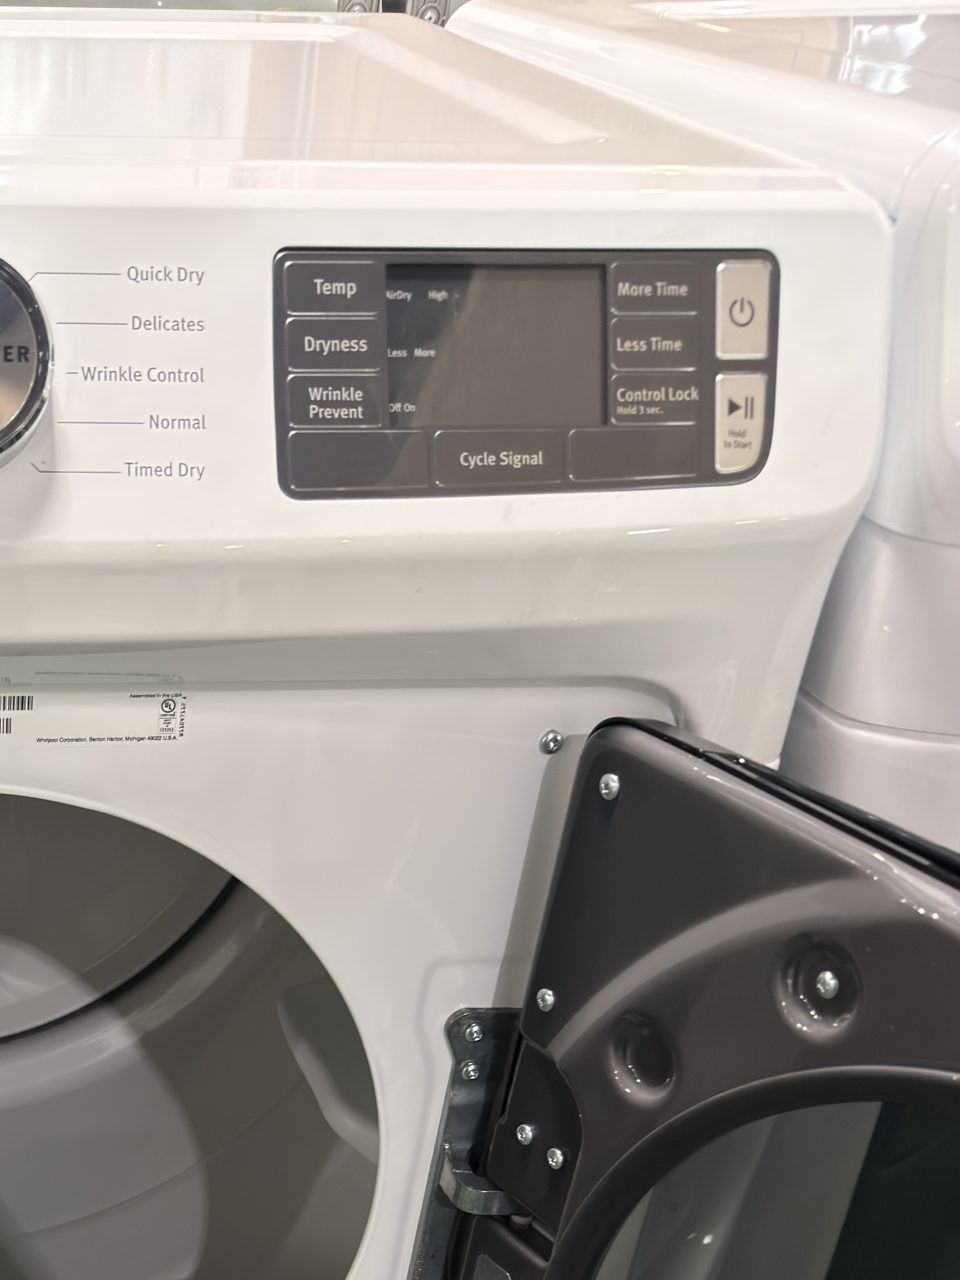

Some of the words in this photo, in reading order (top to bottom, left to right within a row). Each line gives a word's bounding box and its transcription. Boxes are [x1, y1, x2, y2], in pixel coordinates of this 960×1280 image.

[126, 266, 172, 285] Quick
[176, 266, 206, 286] Dry
[314, 278, 357, 298] Temp
[616, 282, 652, 297] More
[654, 281, 688, 297] Time
[130, 315, 206, 332] Delicates
[304, 336, 368, 355] Dryness
[616, 337, 648, 352] Less
[649, 336, 683, 352] Time
[387, 348, 408, 358] Less
[414, 347, 436, 358] More
[80, 366, 144, 382] Wrinkle
[148, 366, 206, 384] Control
[308, 387, 364, 402] Wrinkle
[616, 386, 666, 402] Control
[668, 386, 700, 401] Lock
[309, 404, 364, 420] Prevent
[616, 405, 637, 415] Hold
[646, 406, 664, 415] sec.
[148, 414, 207, 430] Normal
[460, 451, 496, 470] Cycle
[500, 450, 544, 469] Signal
[124, 462, 175, 478] Timed
[178, 462, 206, 481] Dry
